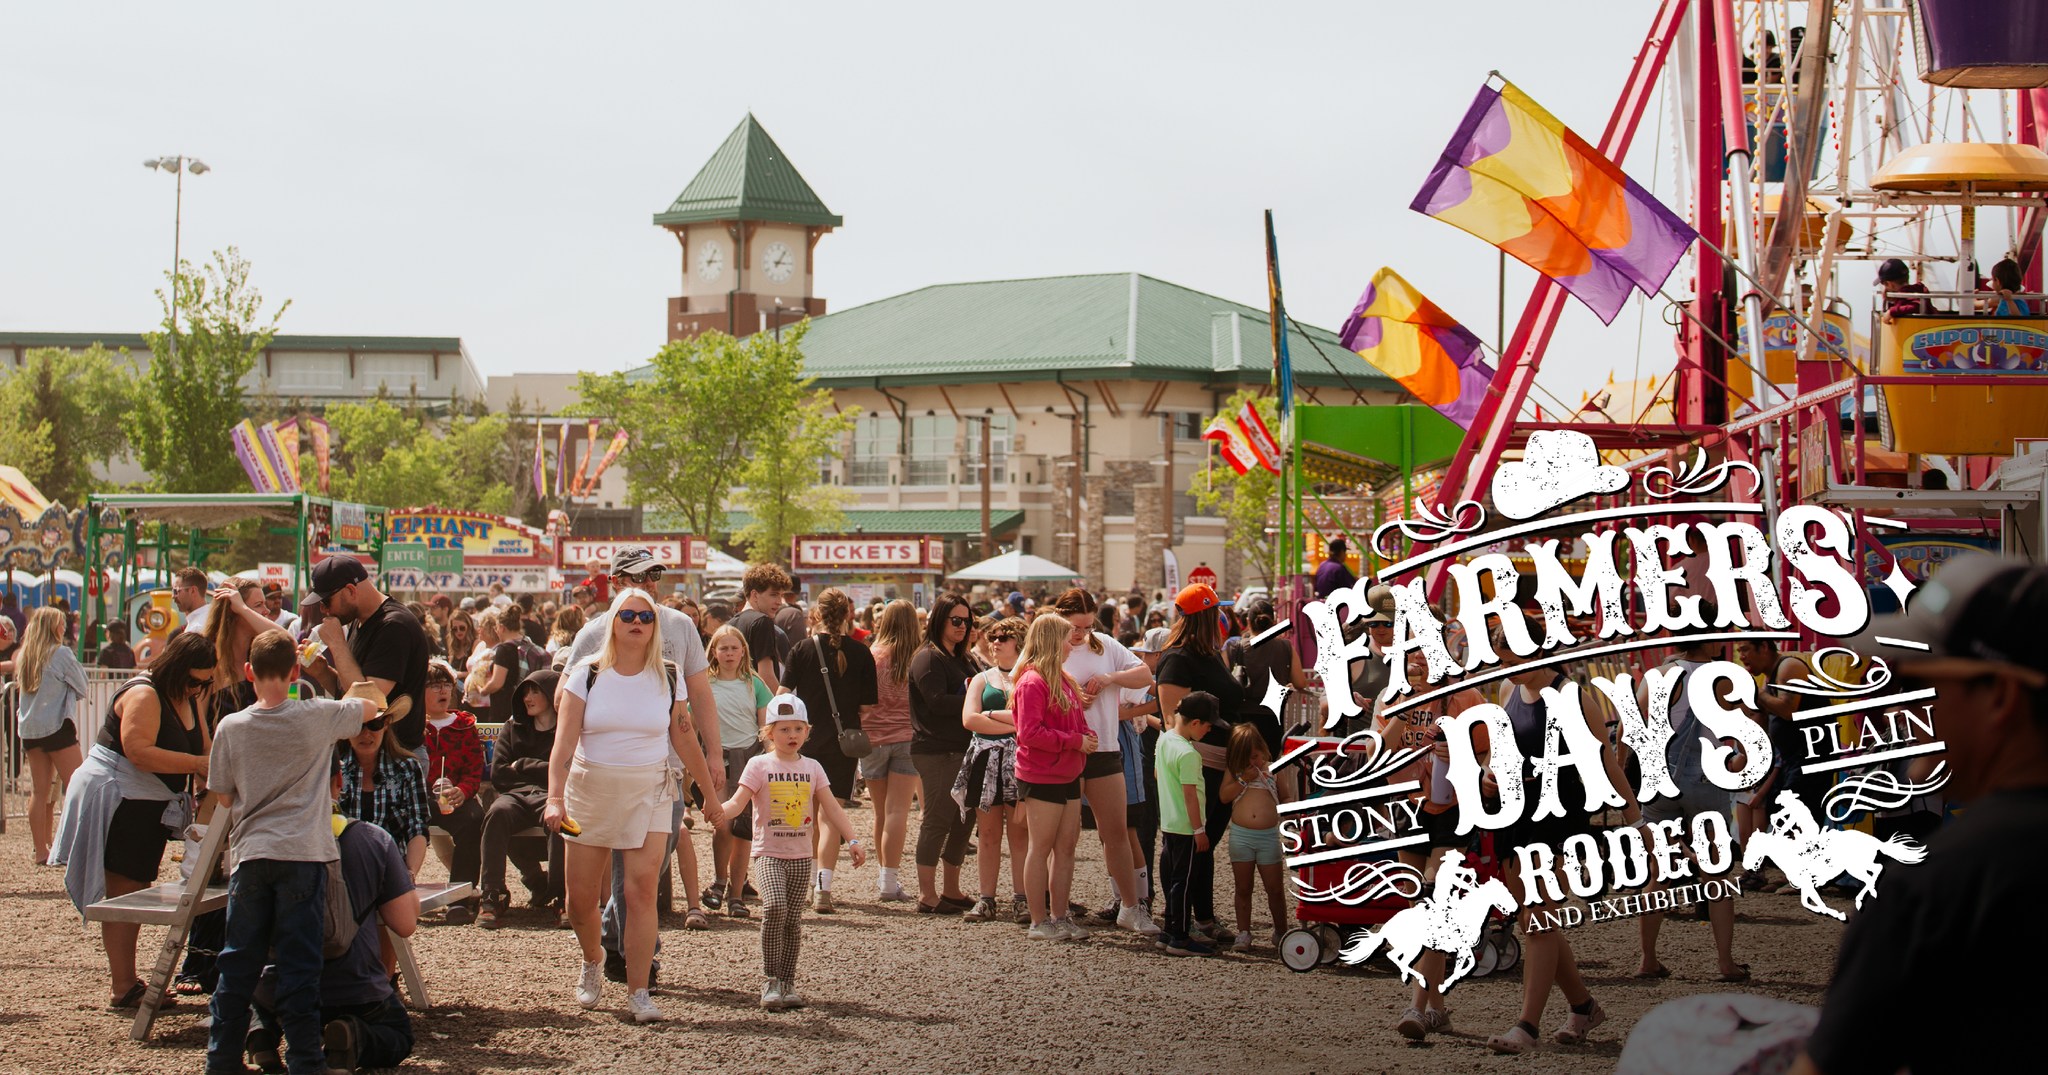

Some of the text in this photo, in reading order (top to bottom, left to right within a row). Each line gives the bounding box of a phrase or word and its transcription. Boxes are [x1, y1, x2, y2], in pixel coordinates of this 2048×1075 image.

[1914, 329, 2048, 350] EXPO WHEE
[1984, 346, 1991, 365] 1
[387, 516, 492, 540] EPHANT
[386, 550, 426, 562] ENTER
[572, 545, 672, 559] TICTS
[810, 545, 911, 559] TICKETS
[429, 555, 453, 567] EXIT
[266, 566, 283, 576] MINI
[1189, 575, 1216, 585] STOP
[477, 727, 501, 736] COU
[768, 773, 811, 783] PIKACHU
